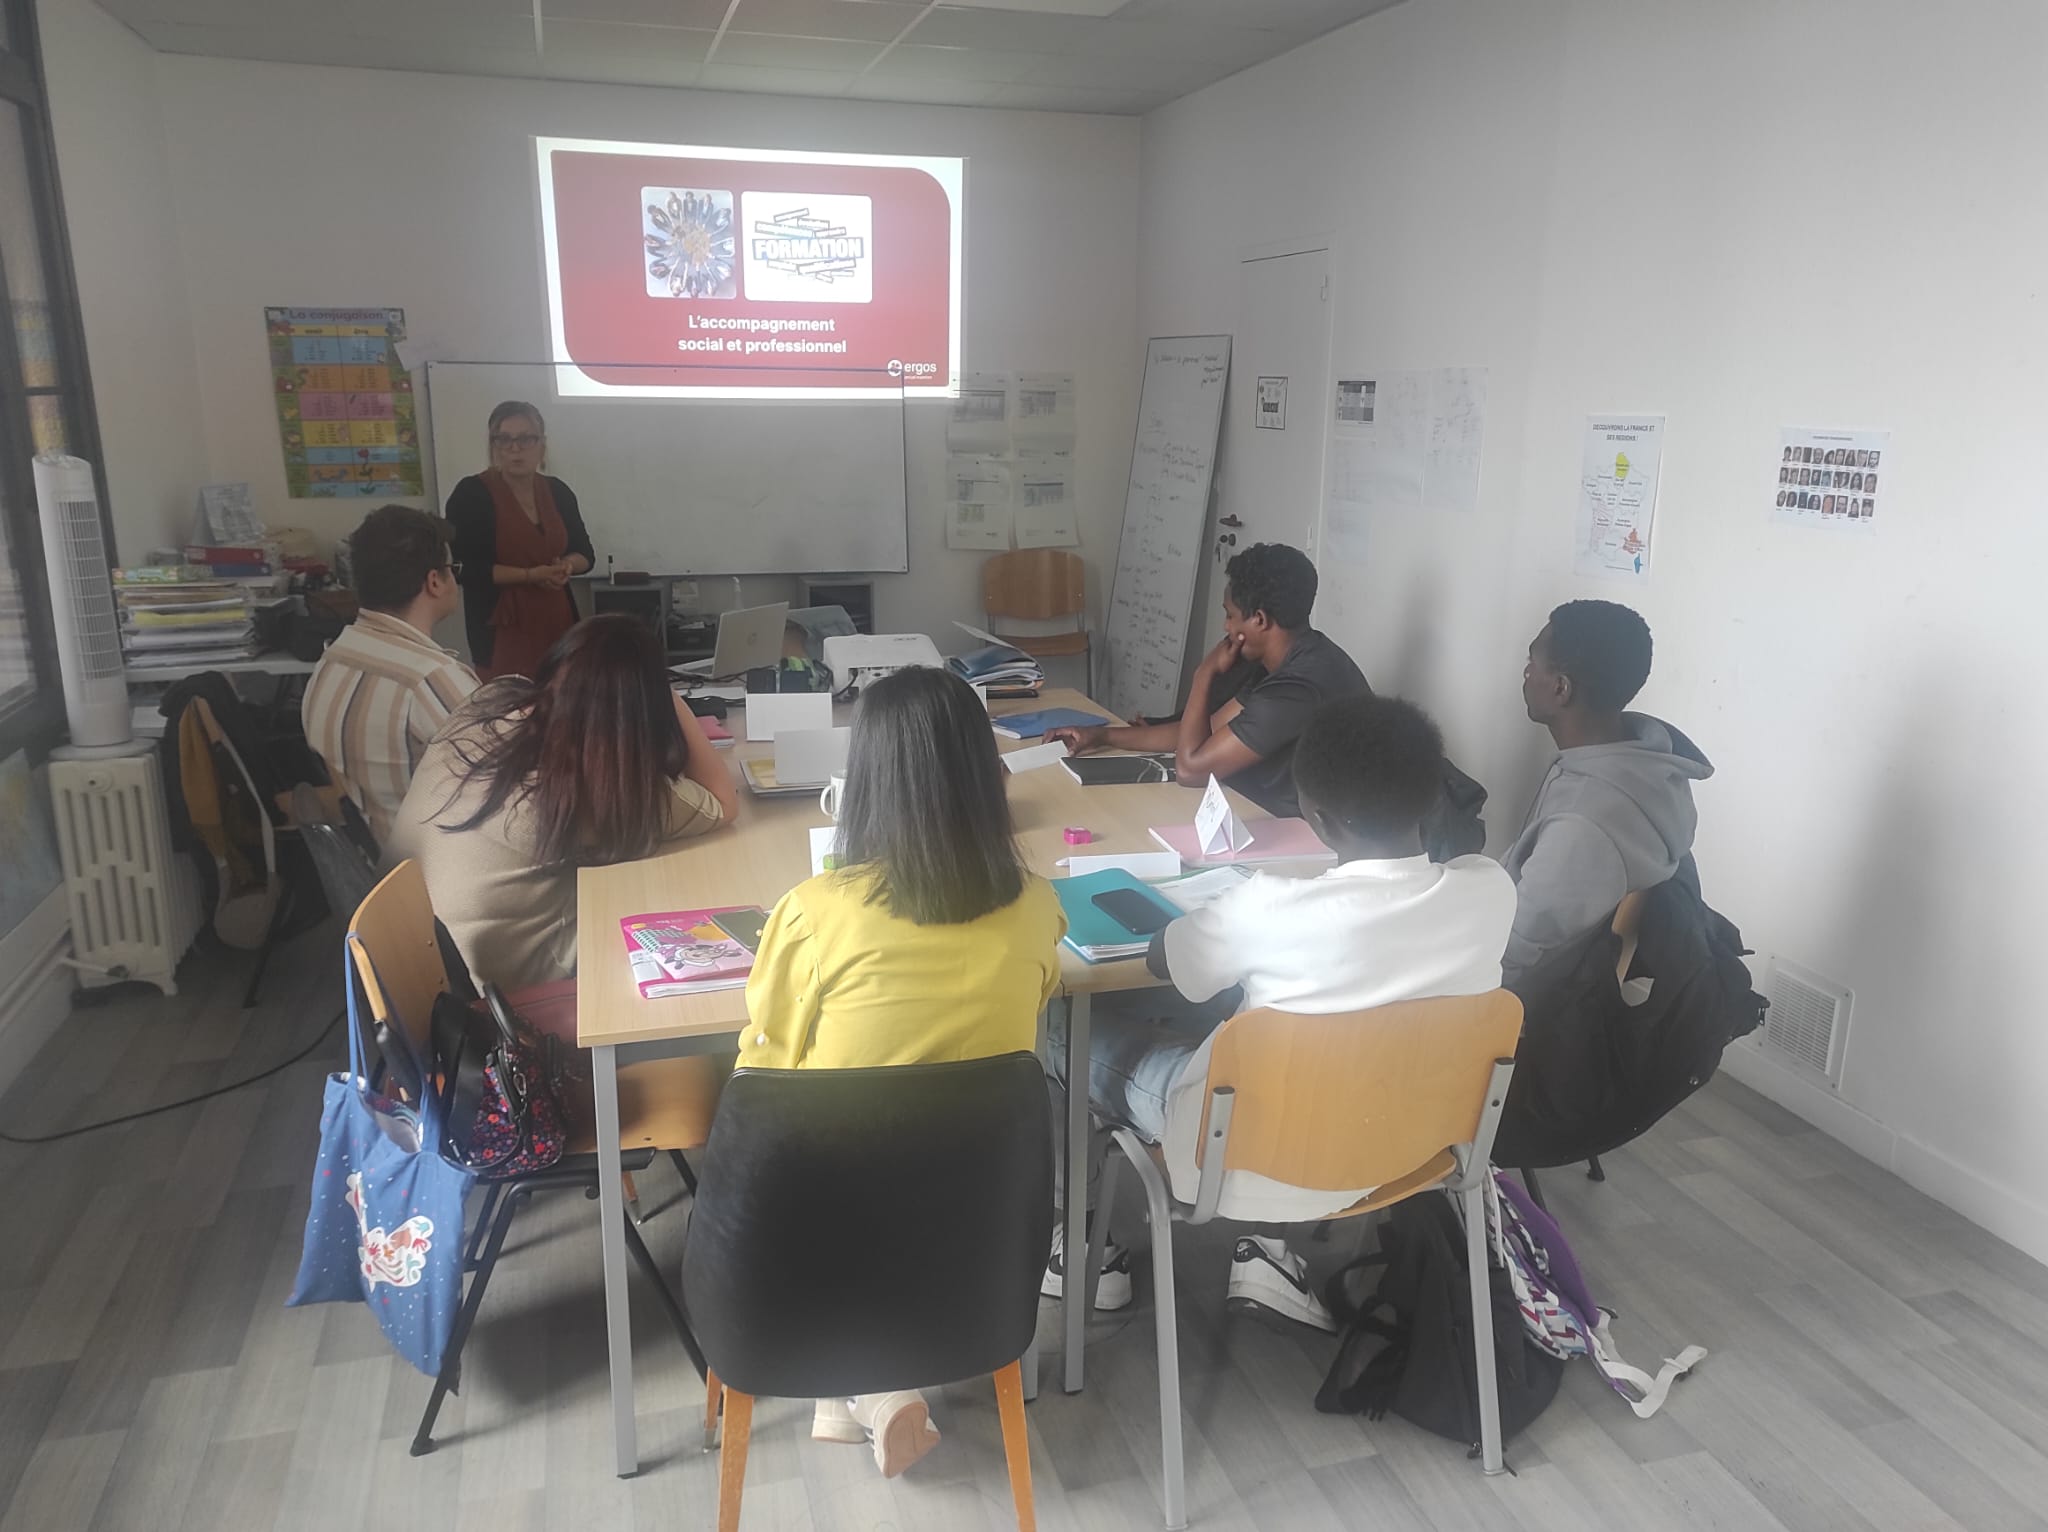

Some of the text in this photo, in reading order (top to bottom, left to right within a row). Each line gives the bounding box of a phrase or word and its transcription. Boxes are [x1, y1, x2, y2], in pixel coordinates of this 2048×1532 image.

[754, 238, 860, 260] FORMATION
[289, 309, 384, 322] La conjugaison
[688, 314, 836, 333] L'accompagnement
[678, 337, 848, 354] social et professionnel
[904, 363, 937, 376] ergos
